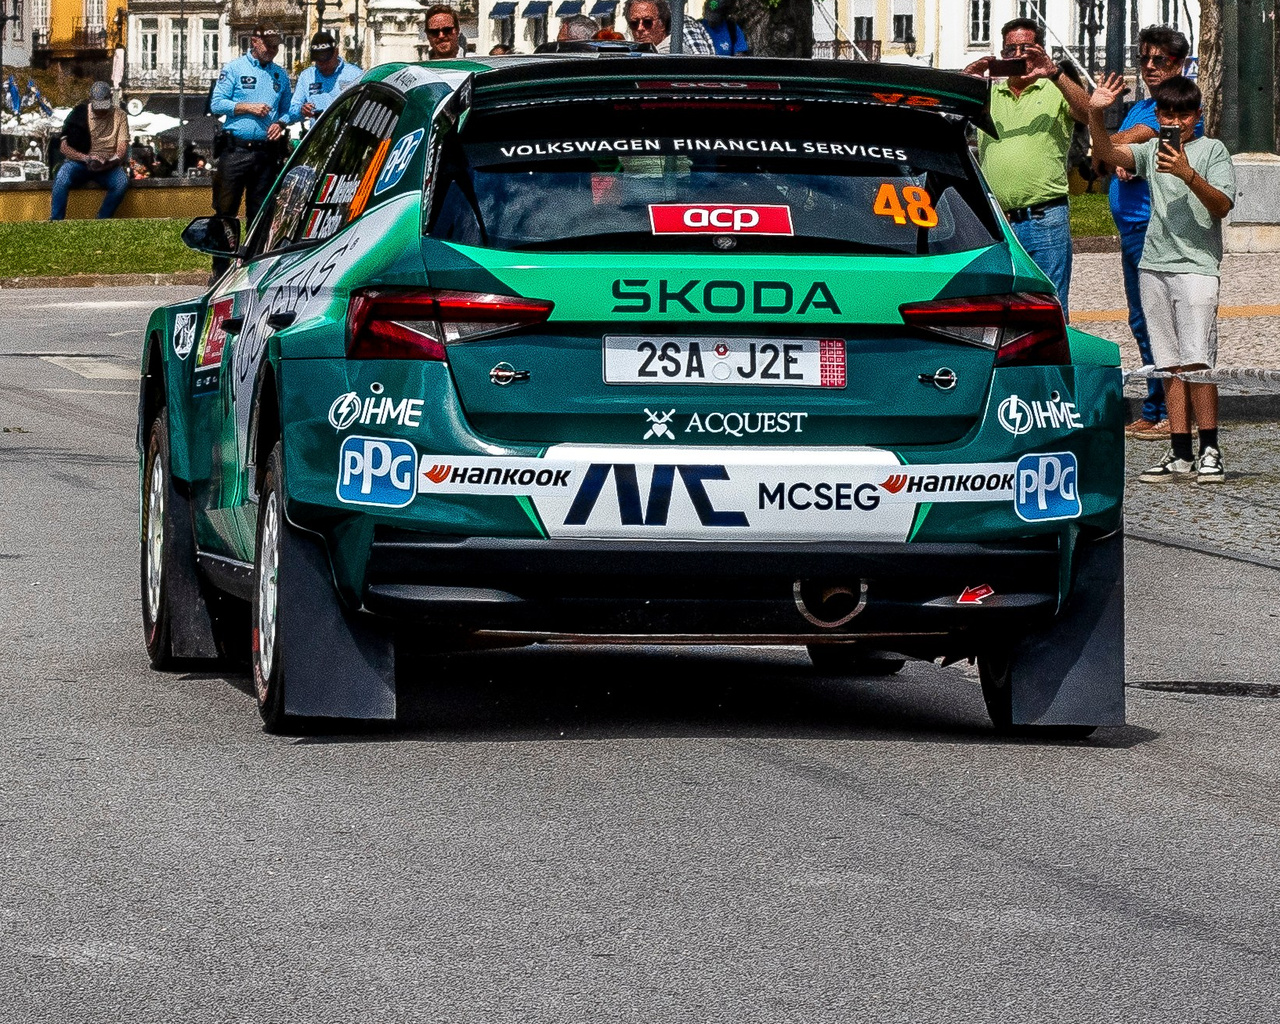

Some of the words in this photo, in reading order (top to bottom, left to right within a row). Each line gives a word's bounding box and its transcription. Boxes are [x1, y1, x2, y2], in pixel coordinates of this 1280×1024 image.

[501, 139, 661, 157] VOLKSWAGEN
[673, 139, 797, 152] FINANCIAL
[803, 142, 908, 161] SERVICES
[683, 208, 760, 231] acp
[873, 183, 938, 227] 48
[637, 341, 706, 378] 2SA
[736, 342, 804, 380] J2E
[359, 397, 425, 427] IHME
[684, 412, 809, 437] ACQUEST
[342, 440, 412, 494] PPG
[758, 481, 880, 511] MCSEG
[1019, 455, 1076, 510] PPG
